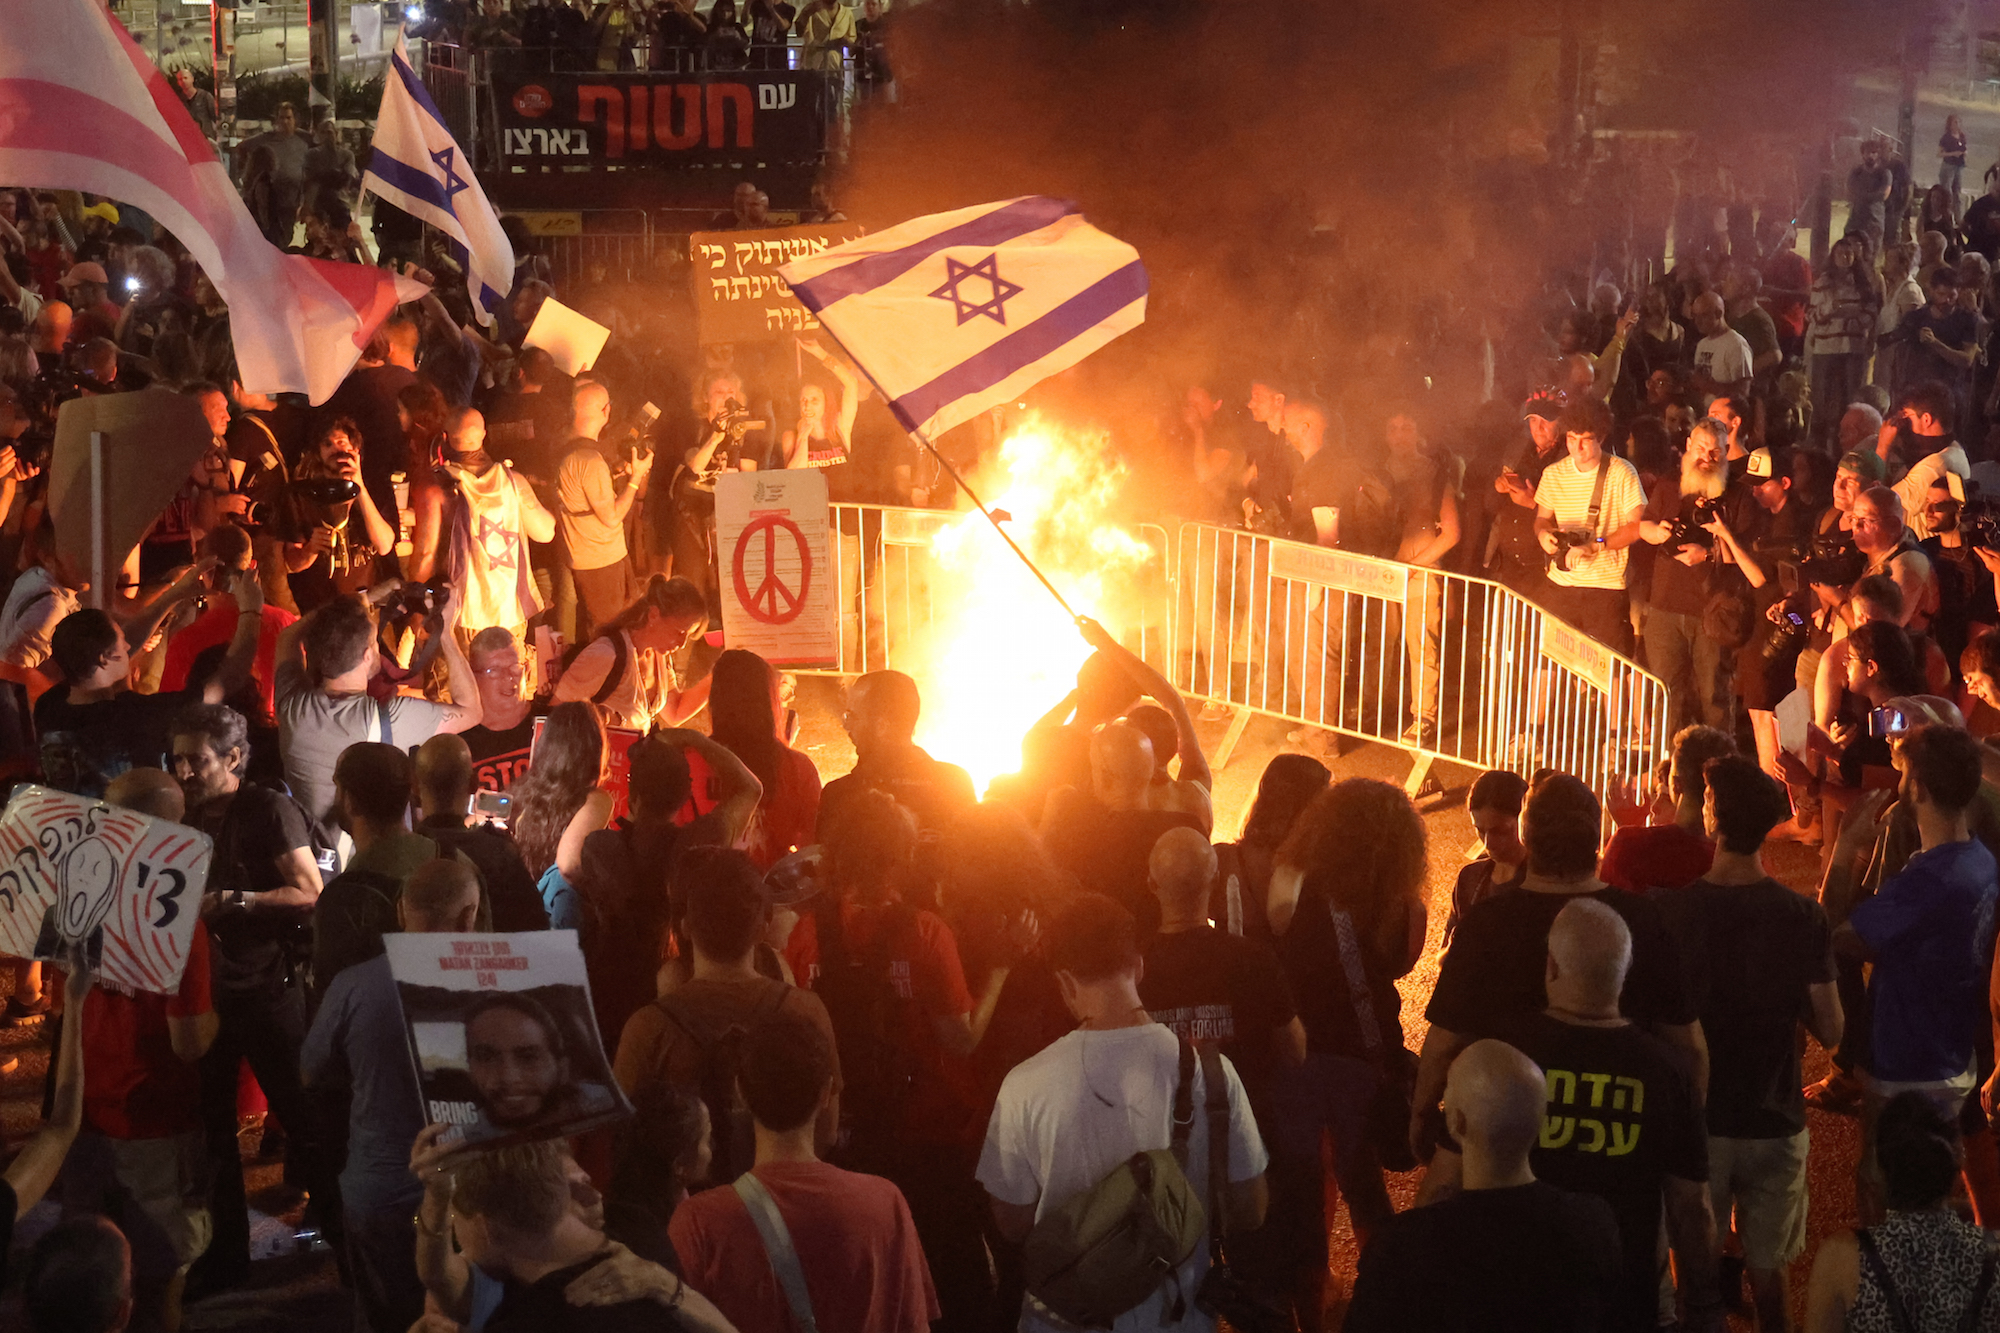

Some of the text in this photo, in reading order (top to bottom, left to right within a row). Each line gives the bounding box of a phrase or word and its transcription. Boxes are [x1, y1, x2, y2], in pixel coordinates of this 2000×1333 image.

[577, 82, 797, 158] עם חטוף
[504, 128, 590, 155] בארצו
[699, 243, 727, 269] כי
[711, 274, 795, 301] שינתה
[765, 305, 820, 331] פניה
[1190, 1018, 1235, 1040] FORUM
[429, 1100, 479, 1124] BRING
